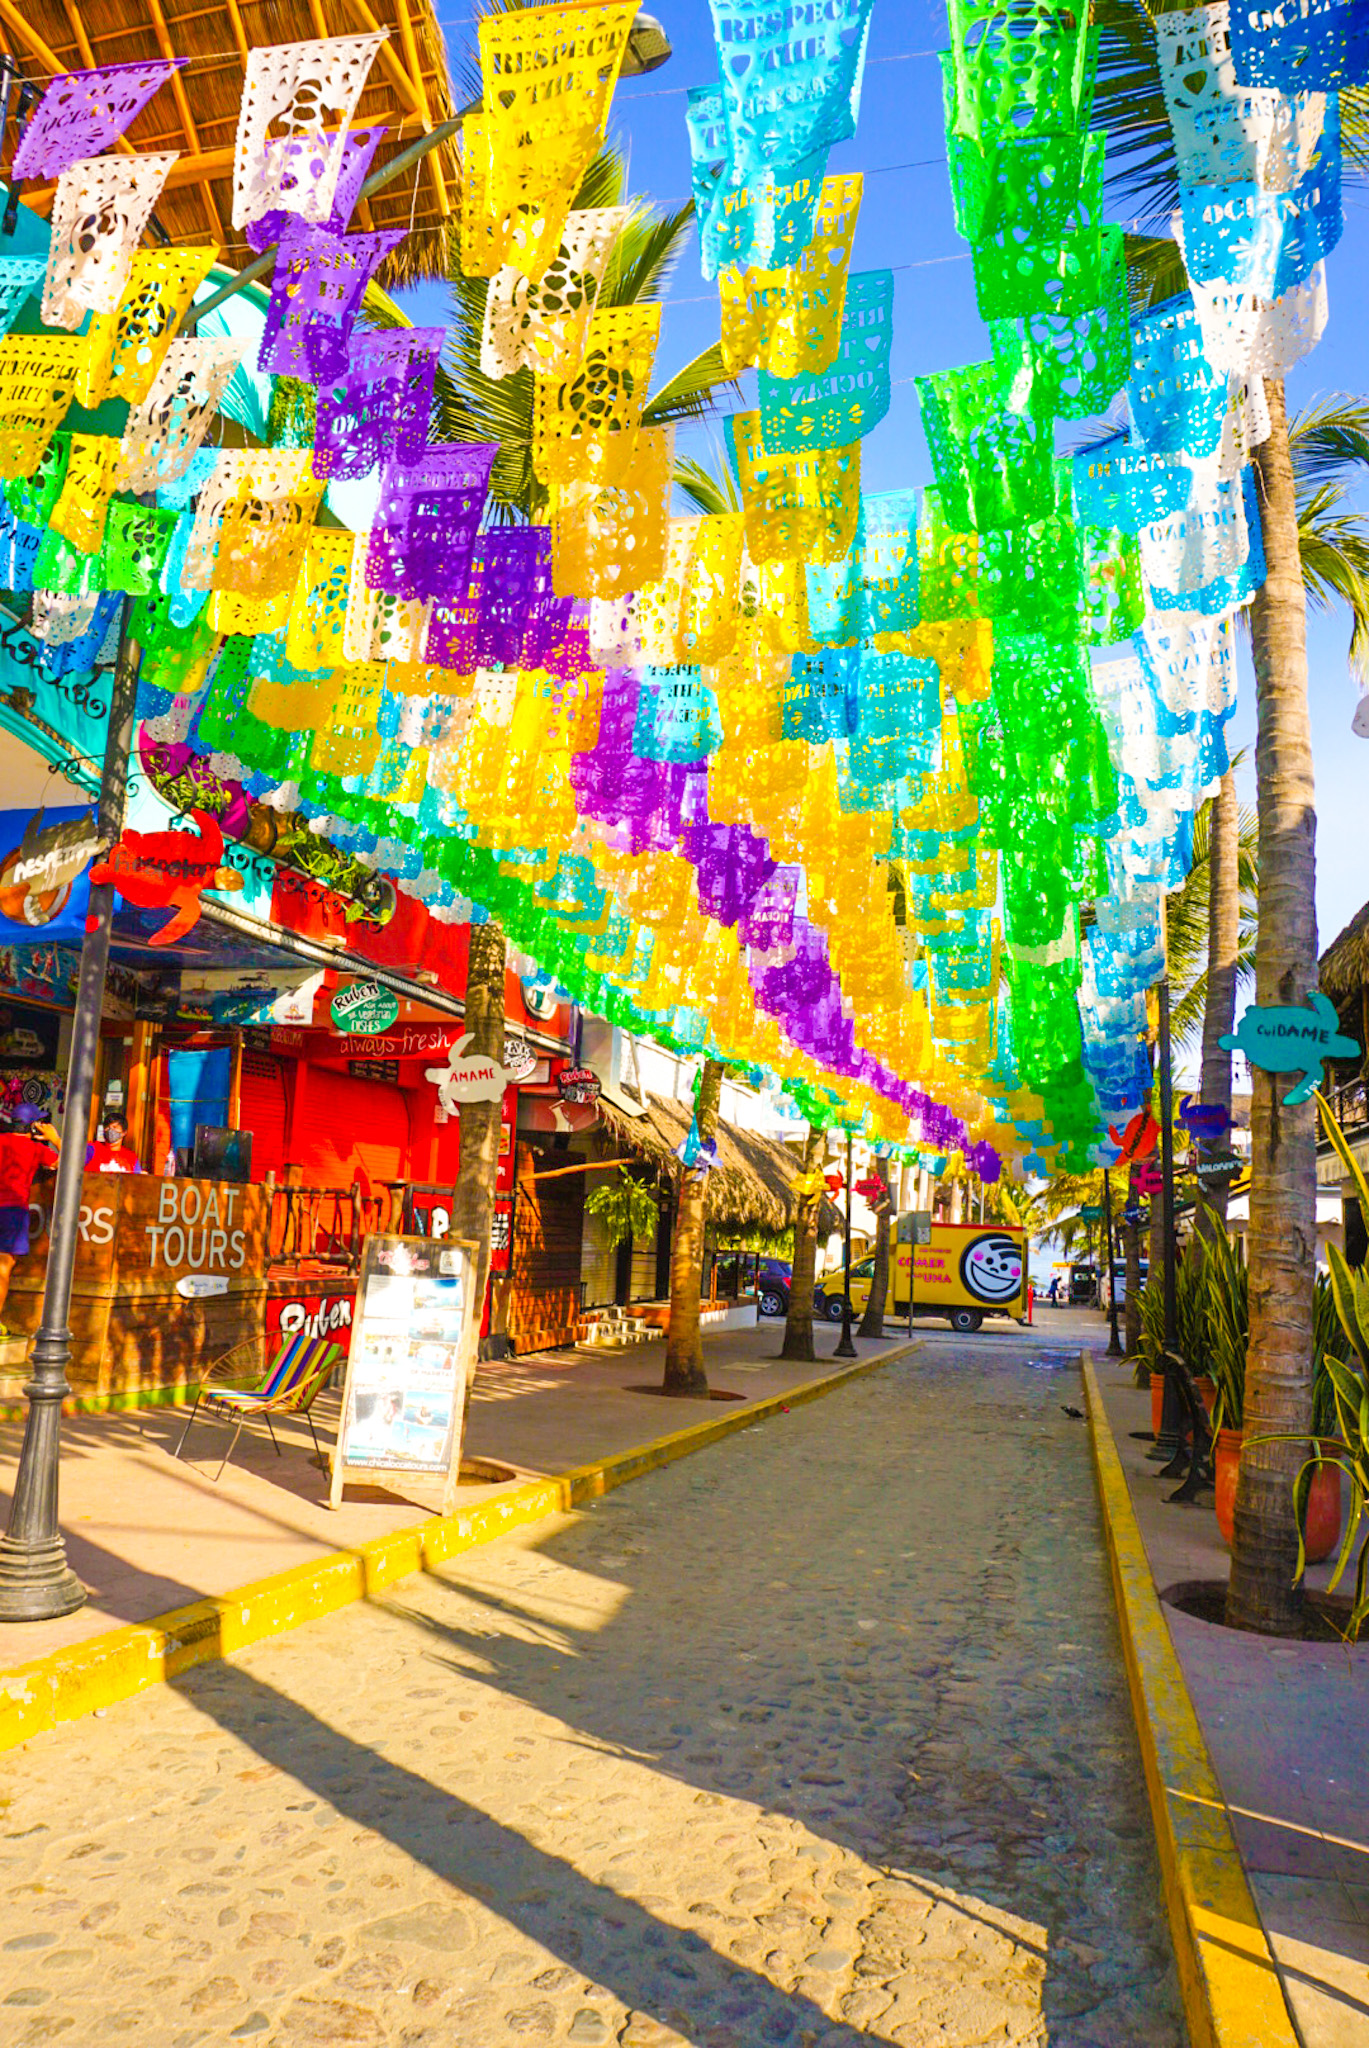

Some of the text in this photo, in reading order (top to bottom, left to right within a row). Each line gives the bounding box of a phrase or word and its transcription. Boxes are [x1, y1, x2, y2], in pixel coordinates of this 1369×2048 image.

[492, 29, 629, 75] RESPECT
[759, 36, 827, 72] THE
[525, 70, 584, 105] THE
[333, 980, 379, 1010] Ruben
[340, 1026, 451, 1057] always fresh
[351, 1020, 381, 1033] DISHES
[158, 1183, 240, 1227] BOAT
[28, 1203, 114, 1244] ORS
[145, 1226, 246, 1269] TOURS
